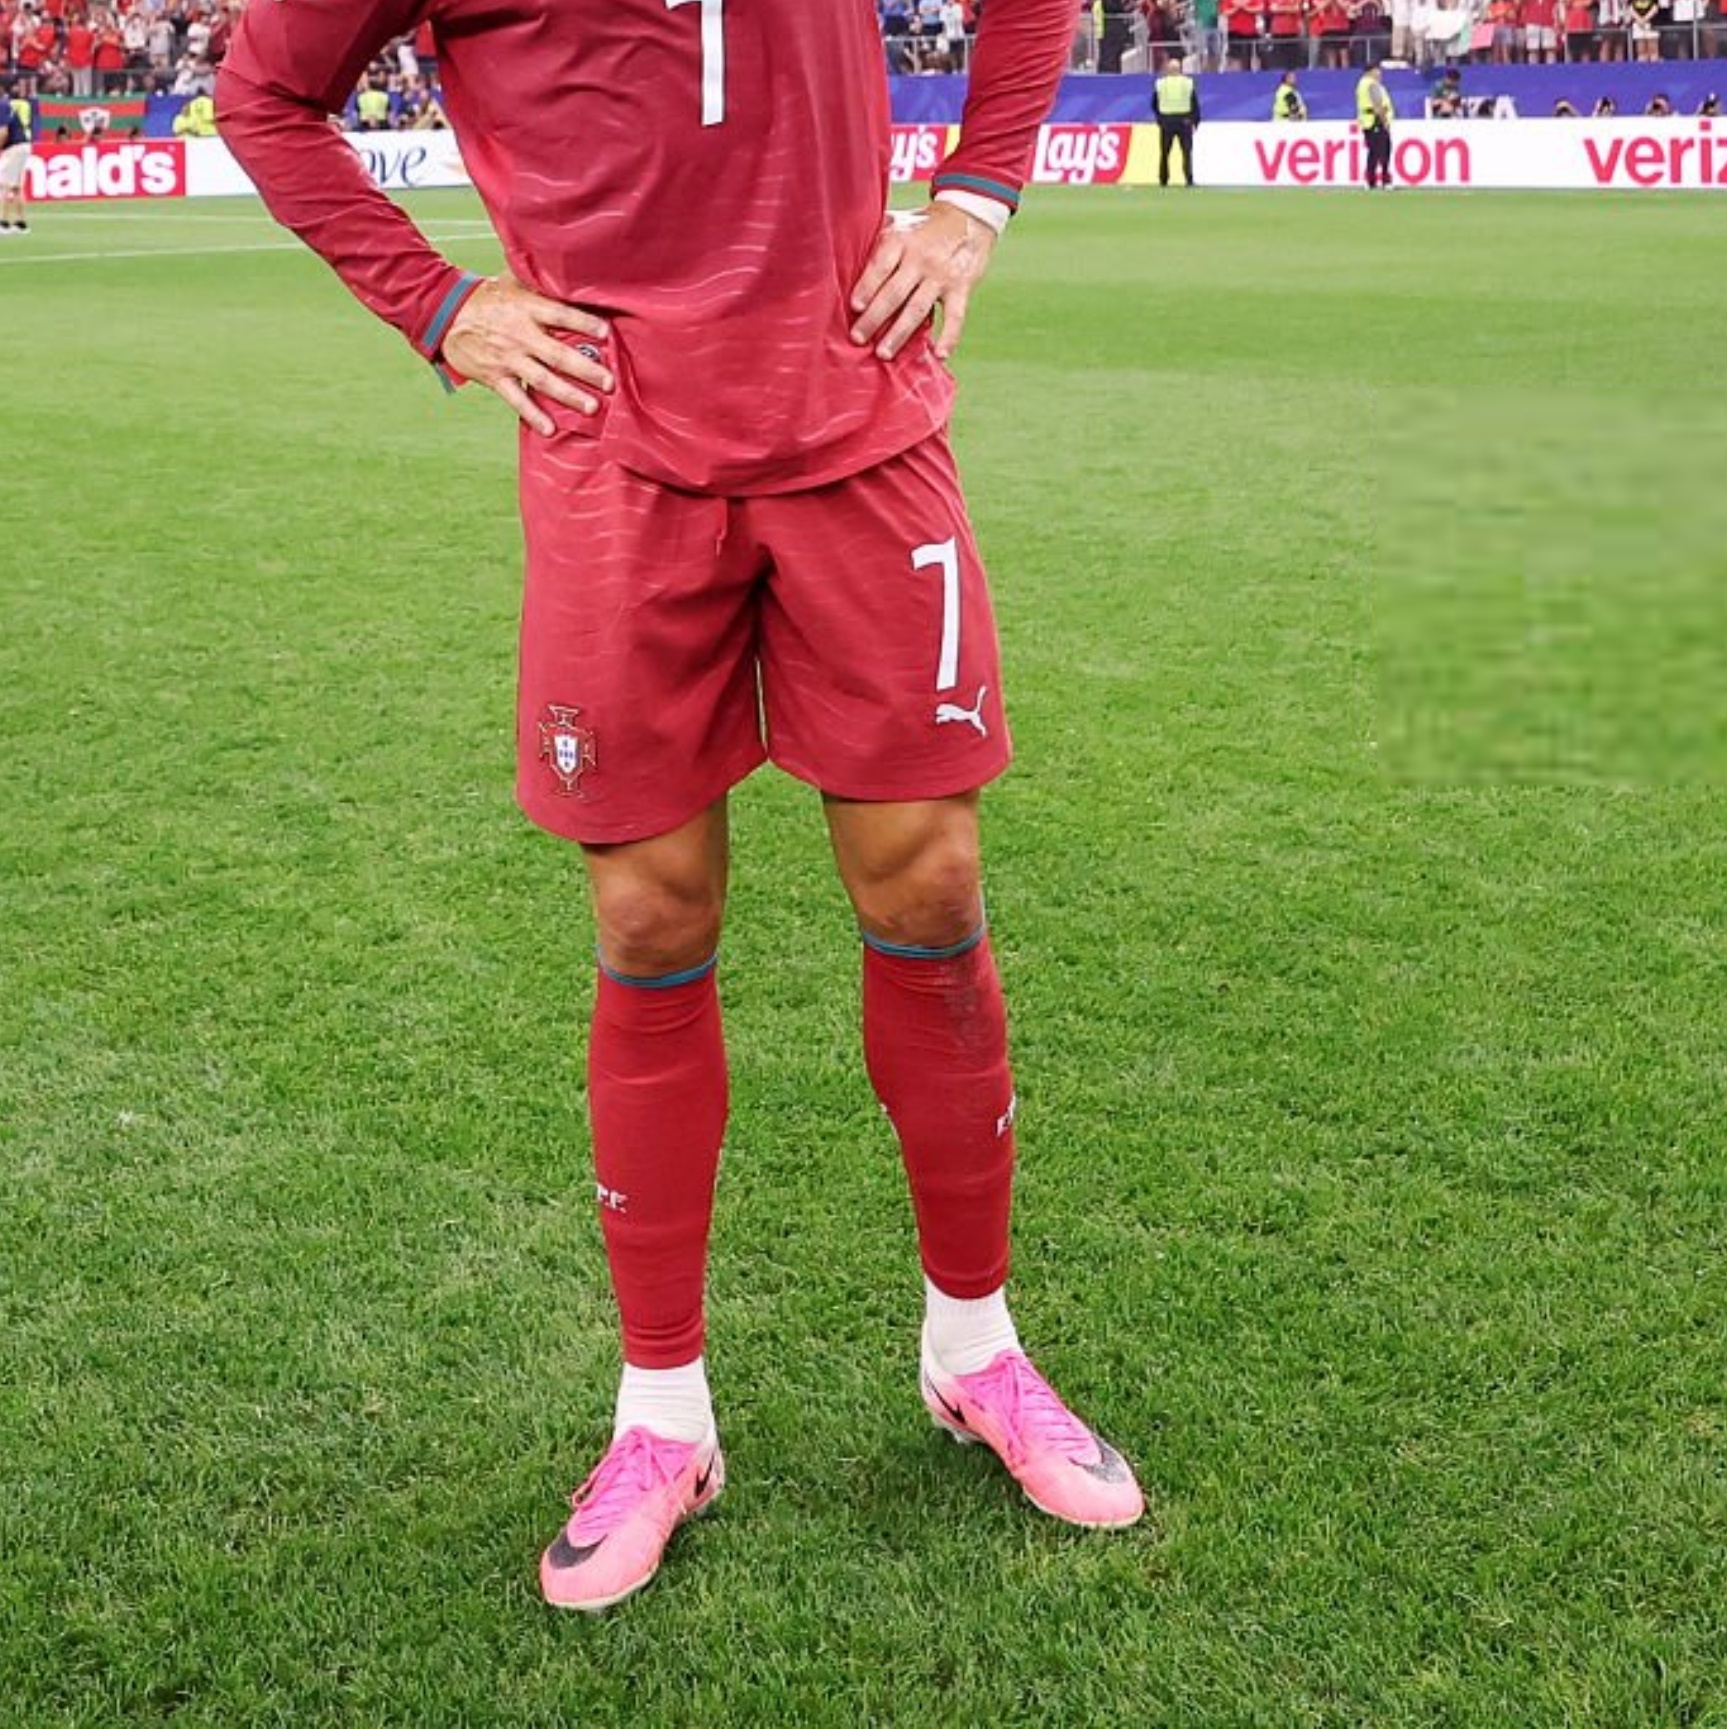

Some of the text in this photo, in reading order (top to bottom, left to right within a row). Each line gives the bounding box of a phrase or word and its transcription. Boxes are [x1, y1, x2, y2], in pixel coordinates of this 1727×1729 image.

[1032, 123, 1120, 183] Lay's
[1255, 124, 1471, 185] verion
[911, 535, 960, 691] 7
